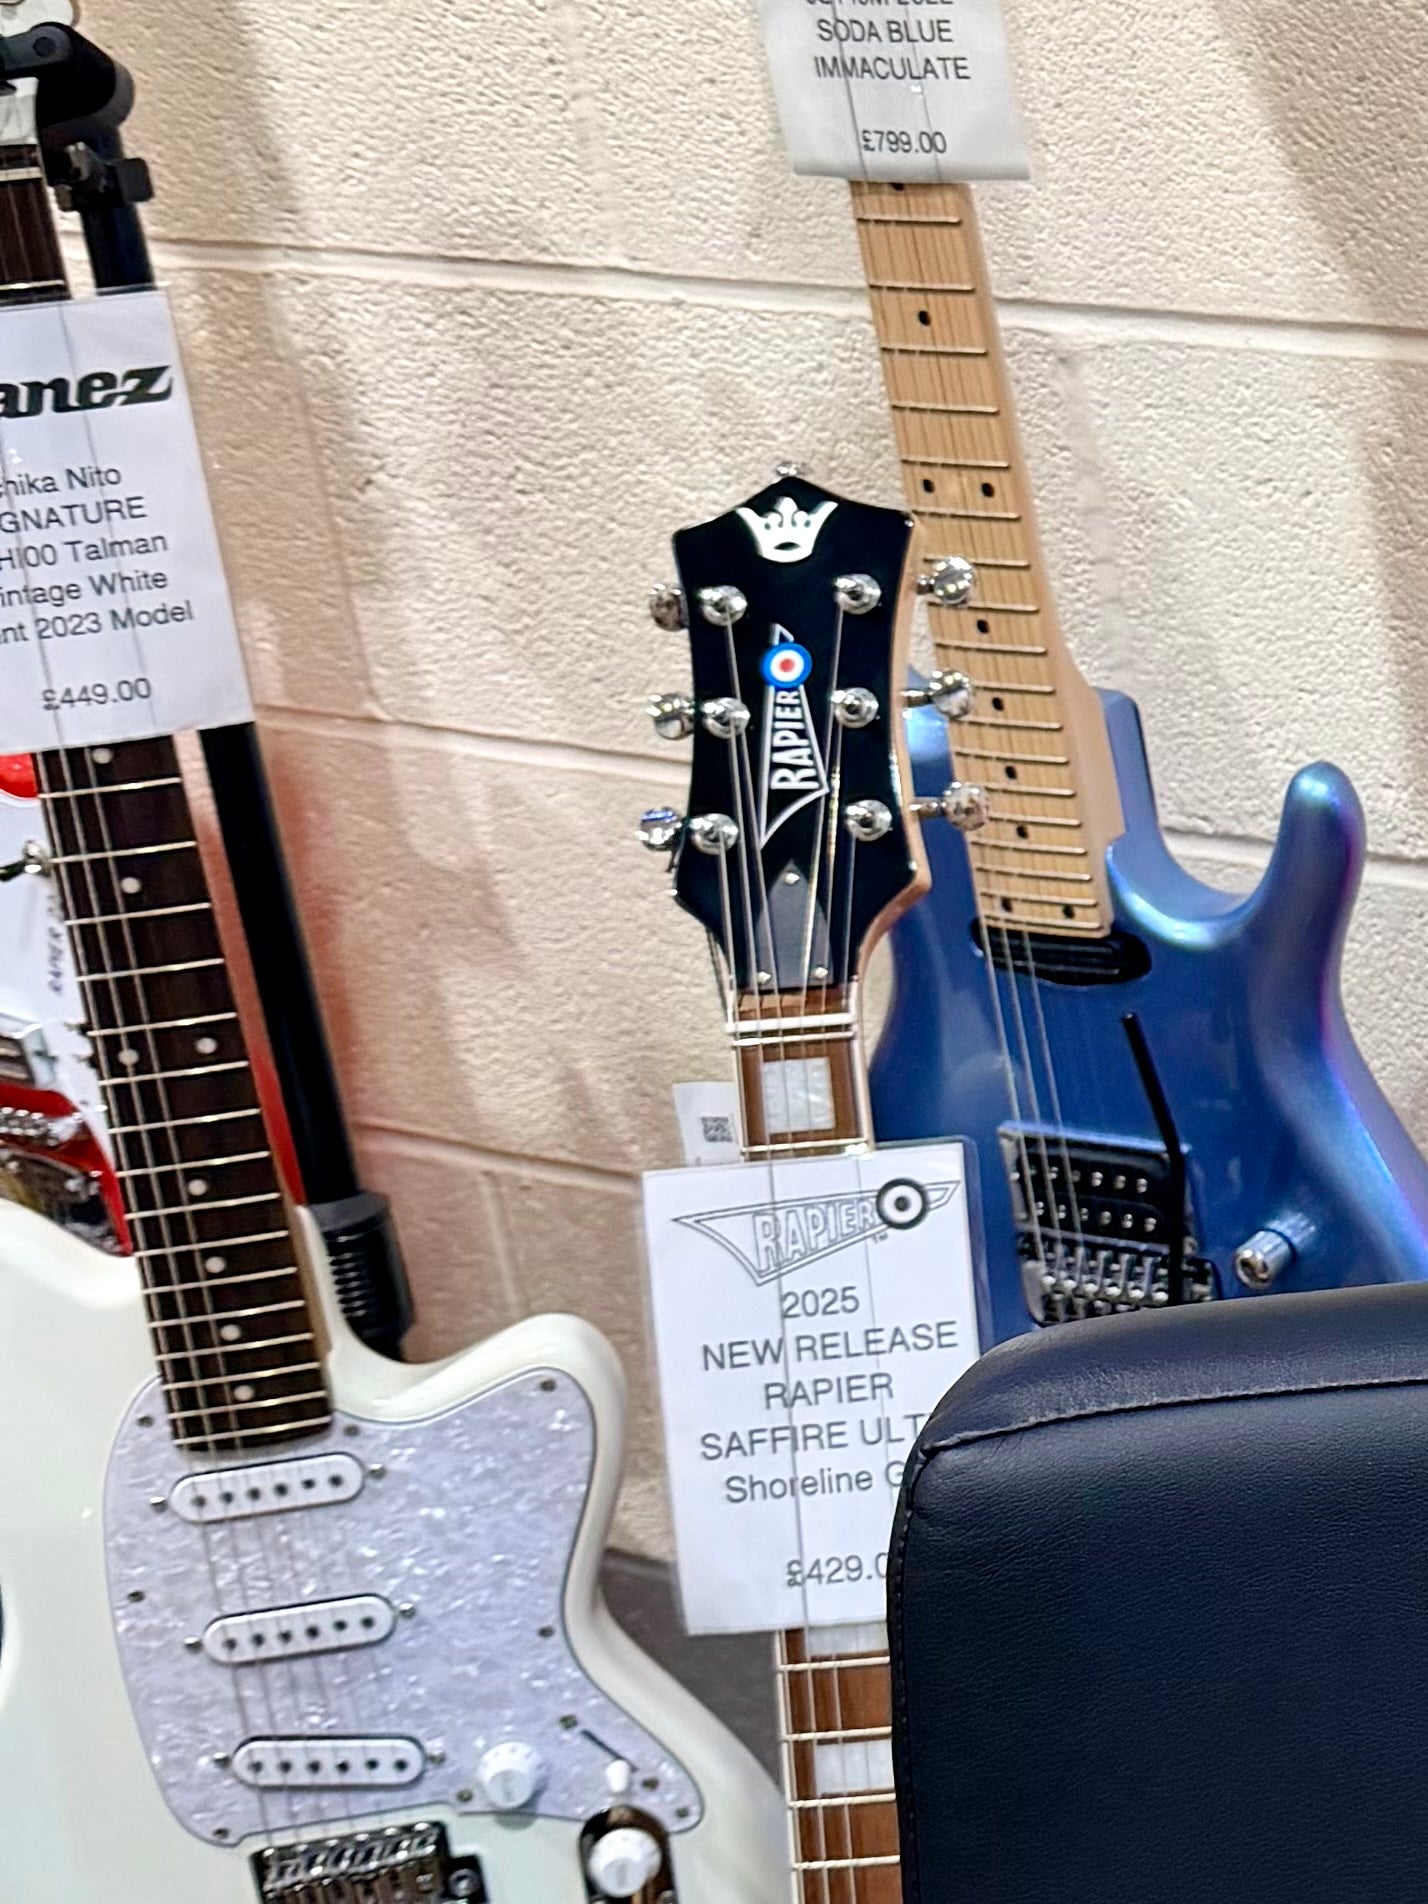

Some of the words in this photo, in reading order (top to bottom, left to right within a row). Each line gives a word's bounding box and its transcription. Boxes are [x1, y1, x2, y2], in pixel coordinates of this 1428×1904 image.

[817, 18, 883, 43] SODA
[887, 19, 954, 43] BLUE
[813, 55, 971, 80] IMMACULATE
[861, 129, 948, 154] £799.00
[0, 472, 59, 497] hika
[65, 465, 122, 490] Nito
[62, 534, 169, 563] Talman
[88, 569, 169, 597] White
[0, 622, 29, 644] nt
[35, 611, 102, 640] 2023
[109, 599, 195, 631] Model
[42, 677, 152, 711] £449.00
[770, 689, 823, 791] RAPIER
[752, 1196, 878, 1274] RAPIER
[781, 1285, 860, 1319] 2025
[702, 1337, 785, 1372] NEW
[795, 1320, 959, 1363] RELEASE
[764, 1372, 895, 1411] RAPIER
[700, 1420, 849, 1462] SAFFIRE
[859, 1412, 934, 1447] ULT
[725, 1467, 873, 1505] Shoreline
